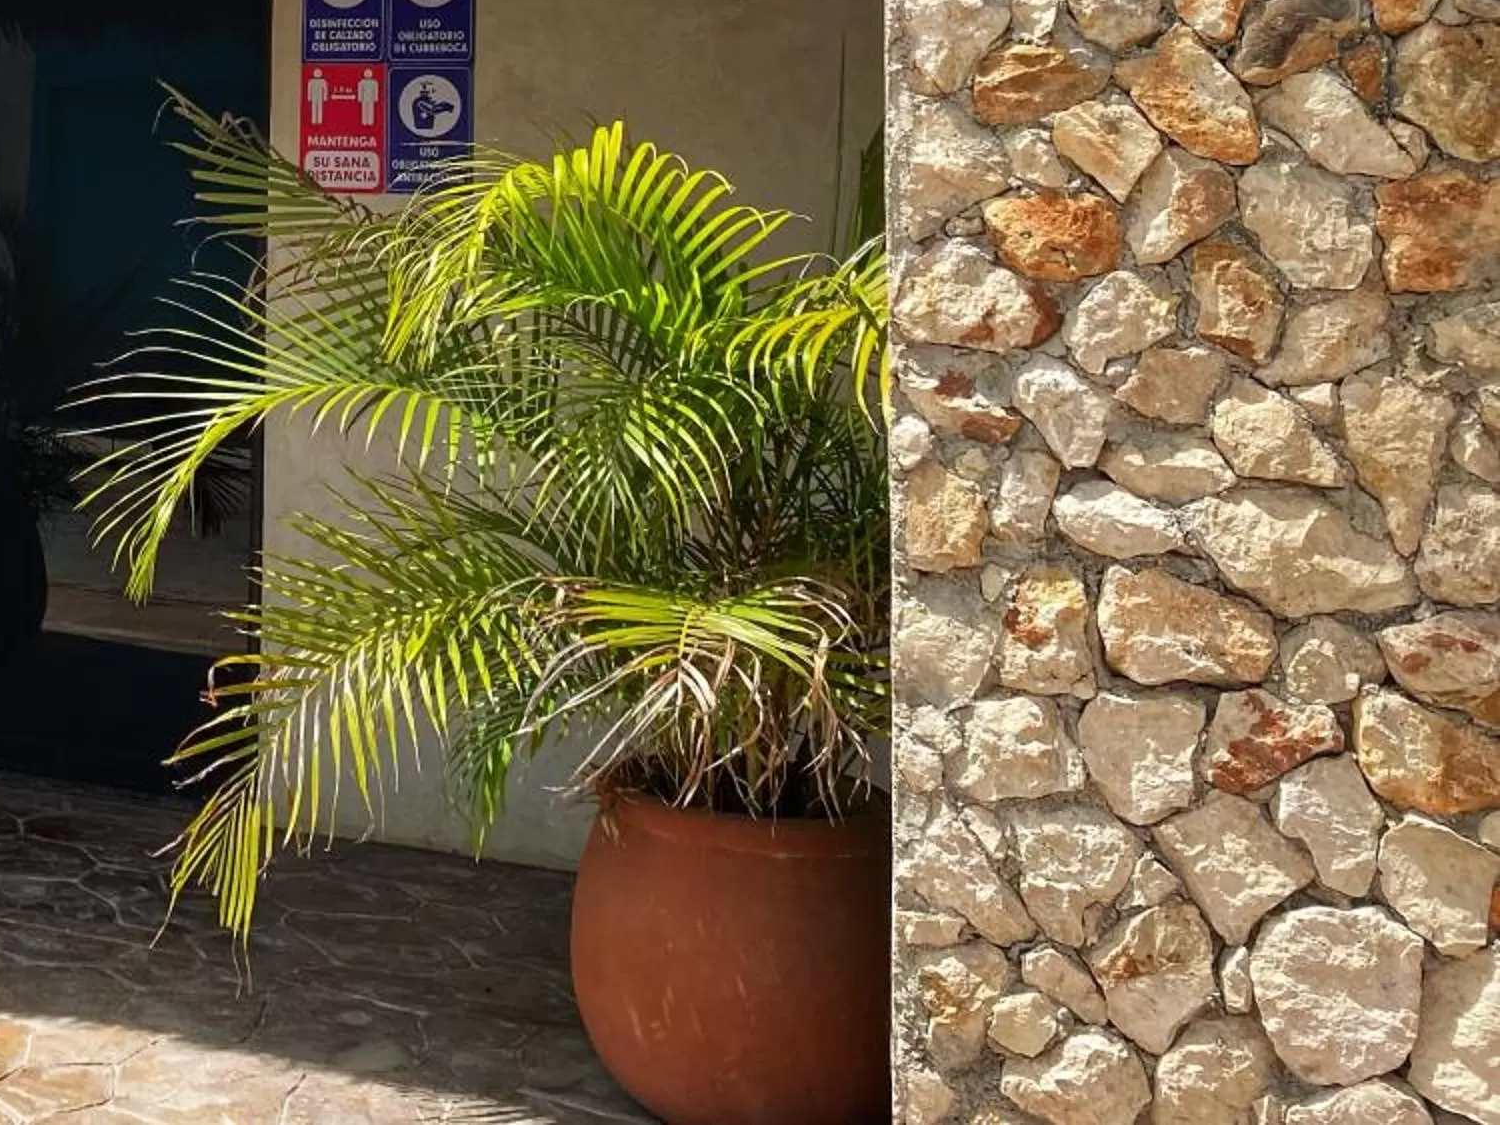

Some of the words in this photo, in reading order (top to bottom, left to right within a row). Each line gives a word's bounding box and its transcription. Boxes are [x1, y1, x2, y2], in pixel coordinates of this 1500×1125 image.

[419, 18, 441, 28] USO
[311, 42, 377, 52] OBLIGATORIO
[307, 135, 377, 147] MANTENGA
[313, 157, 330, 168] SU
[334, 156, 371, 168] SANA
